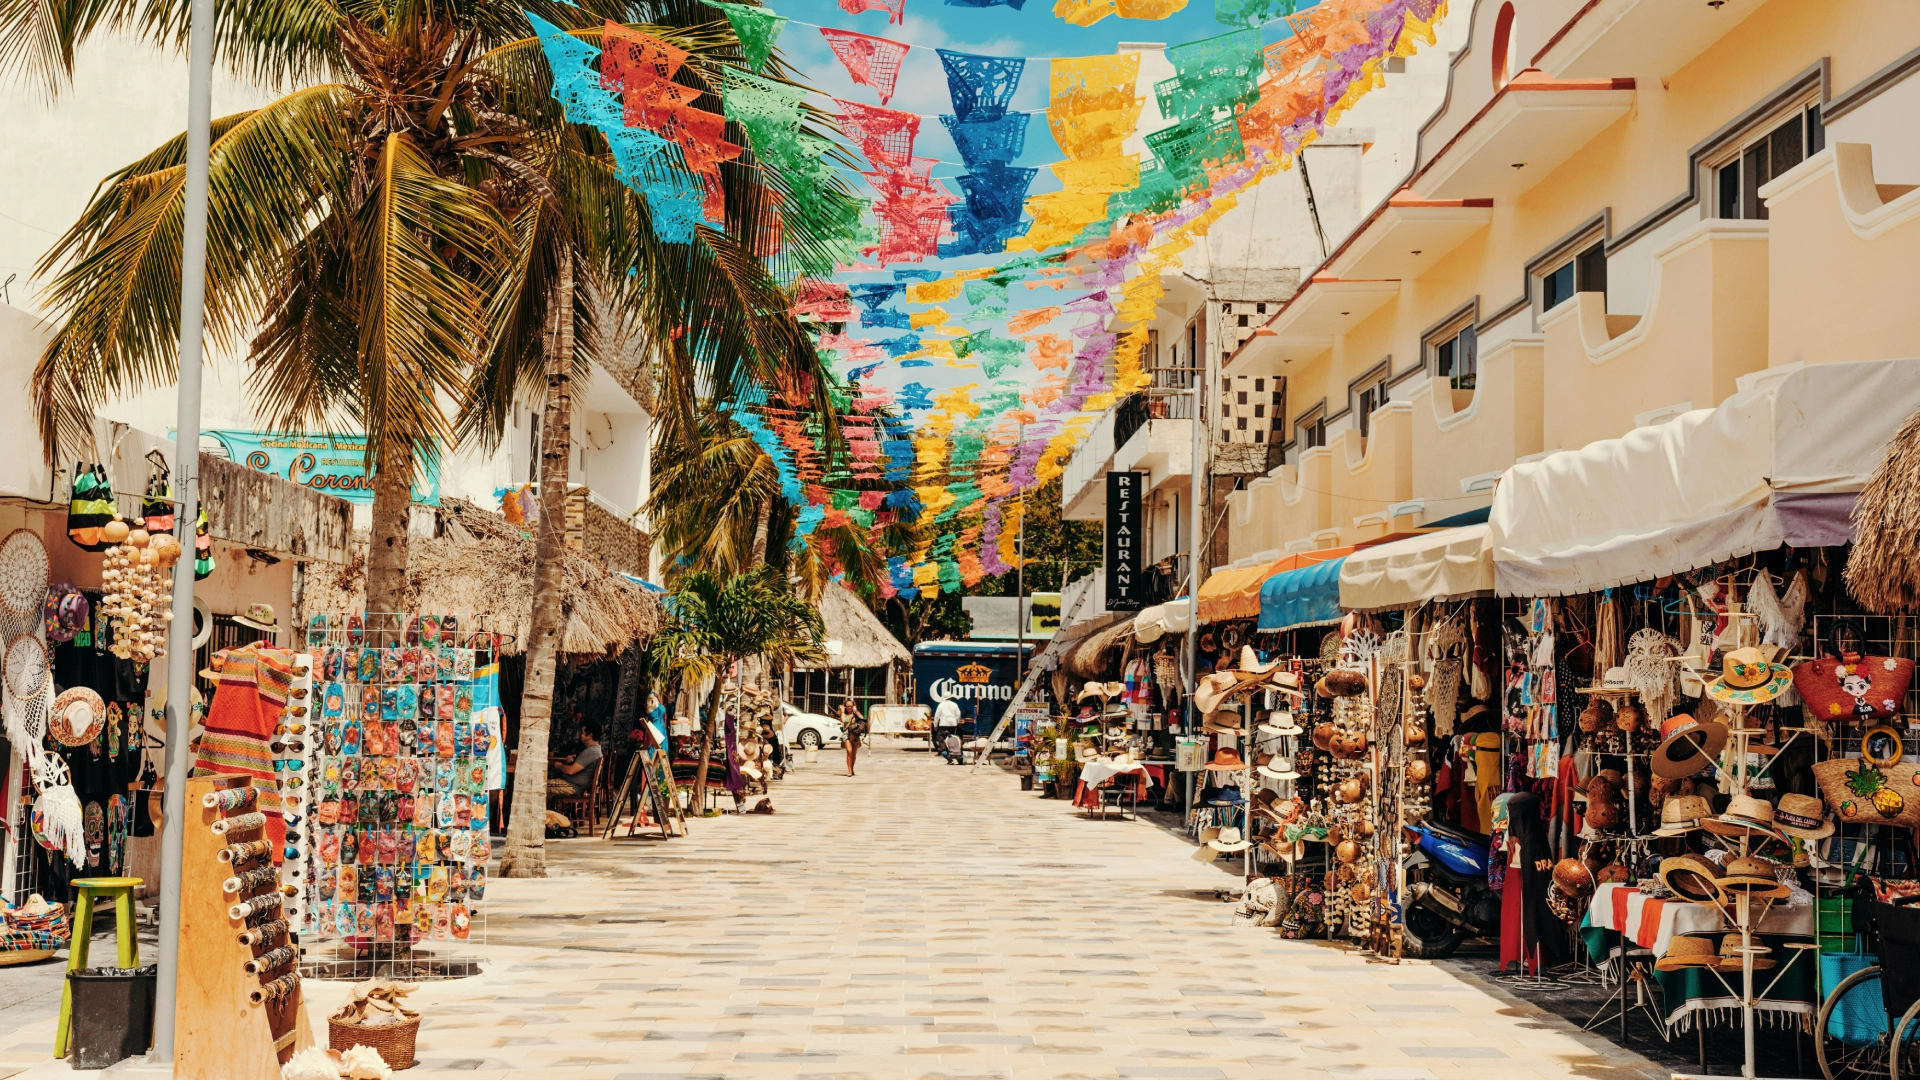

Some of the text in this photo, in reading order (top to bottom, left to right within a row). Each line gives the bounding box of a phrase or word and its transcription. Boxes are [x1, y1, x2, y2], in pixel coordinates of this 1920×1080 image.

[261, 439, 328, 449] Cocina Mexicana
[1116, 476, 1131, 597] RESTAURANT
[929, 677, 1012, 703] Corona
